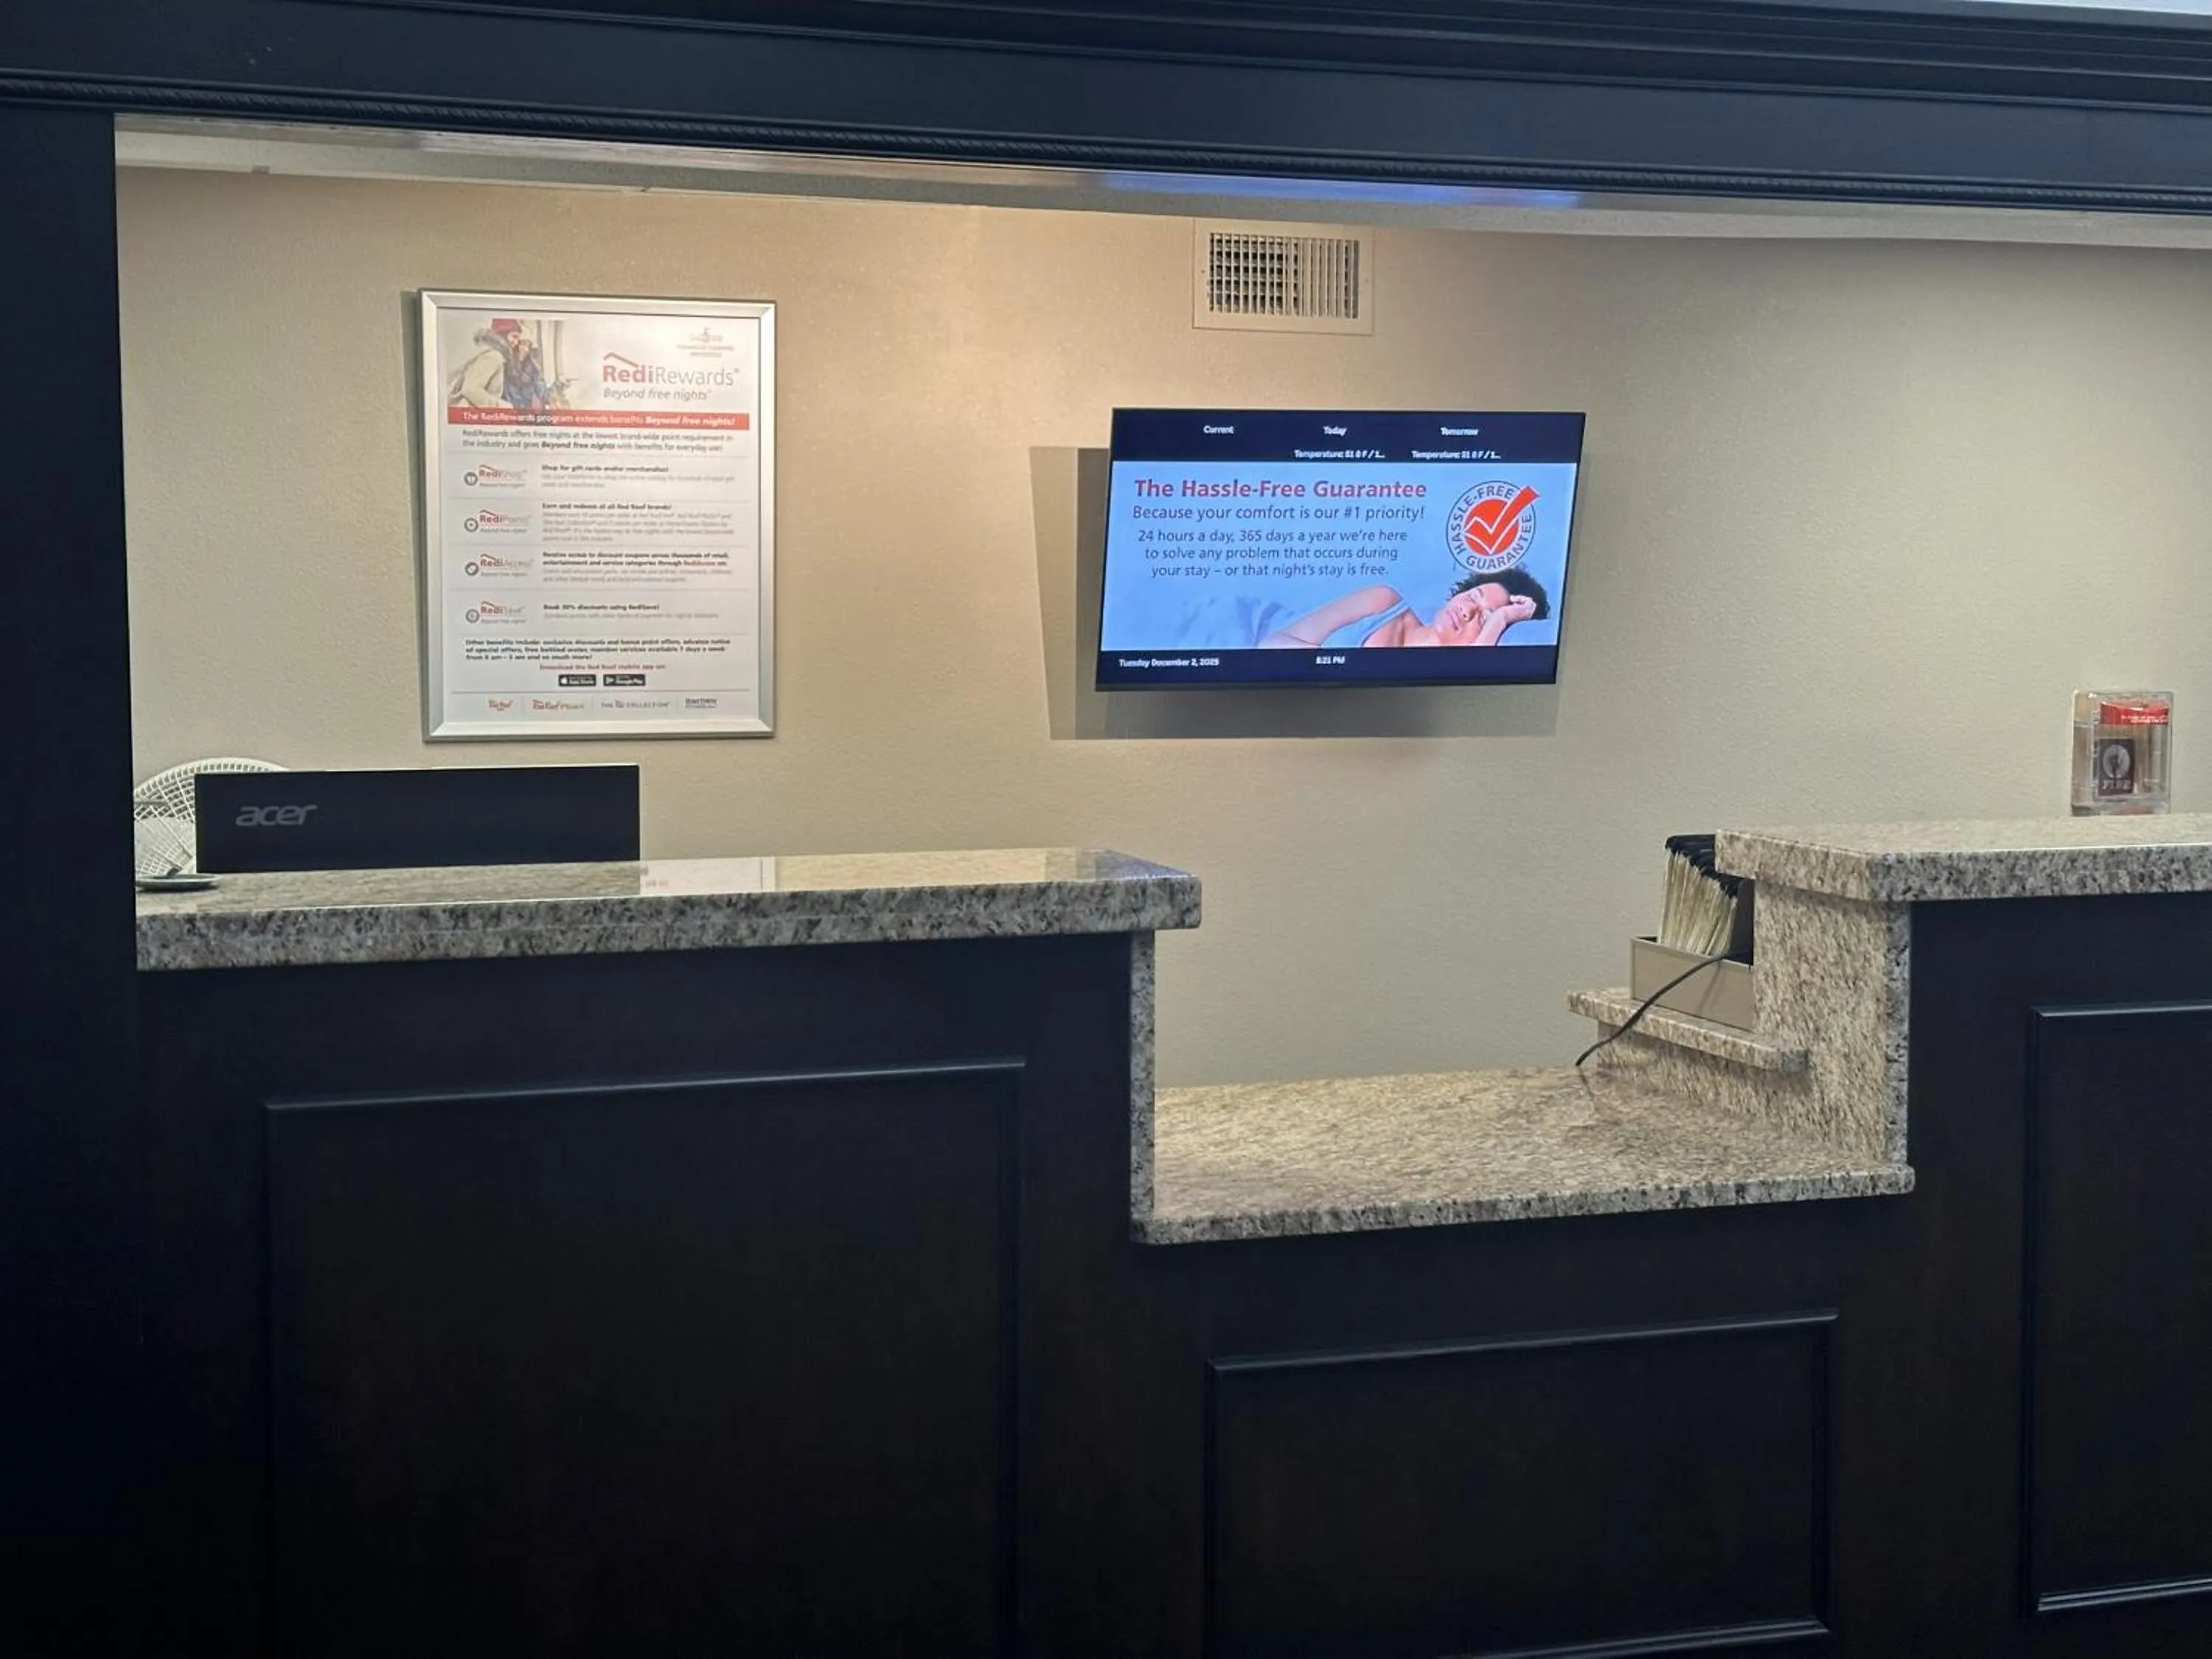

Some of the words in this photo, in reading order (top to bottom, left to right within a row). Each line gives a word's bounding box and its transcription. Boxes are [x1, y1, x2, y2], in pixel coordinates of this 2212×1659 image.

[602, 364, 734, 386] RediRewards
[603, 387, 645, 401] Beyond
[648, 388, 671, 399] free
[673, 389, 708, 402] nights
[463, 411, 479, 421] The
[536, 414, 574, 426] program
[645, 415, 681, 427] Beyond
[682, 415, 702, 425] free
[703, 416, 736, 428] nights!
[1203, 425, 1234, 434] Current
[1323, 425, 1348, 436] Today
[1440, 426, 1478, 436] Tomorrow
[541, 440, 571, 451] Beyond
[573, 441, 589, 449] free
[591, 441, 615, 451] nights
[1135, 479, 1174, 498] The
[1181, 479, 1306, 498] Hassle-Free
[1313, 480, 1427, 498] Guarantee
[1133, 505, 1192, 519] Because
[1196, 507, 1233, 523] your
[1235, 504, 1295, 519] comfort
[1300, 505, 1310, 518] is
[1314, 507, 1340, 519] our
[1344, 506, 1360, 519] #1
[1366, 505, 1425, 522] priority!
[1451, 484, 1514, 555] HASSLE-FREE
[1138, 530, 1154, 542] 24
[1158, 529, 1194, 542] hours
[1197, 532, 1206, 542] a
[1209, 529, 1235, 544] day,
[1239, 529, 1262, 542] 365
[1266, 529, 1294, 544] days
[1298, 532, 1305, 542] a
[1309, 532, 1336, 544] year
[1340, 529, 1375, 542] we're
[1378, 529, 1408, 542] here
[1466, 513, 1532, 570] GUARANTEE
[1145, 549, 1158, 560] to
[1163, 546, 1195, 560] solve
[1199, 549, 1222, 561] any
[1225, 546, 1279, 561] problem
[1284, 547, 1311, 559] that
[1313, 549, 1353, 560] occurs
[1356, 546, 1398, 561] during
[1152, 566, 1181, 579] your
[1185, 566, 1211, 579] stay
[1225, 566, 1239, 576] or
[1242, 565, 1269, 576] that
[1273, 564, 1315, 579] night's
[1318, 565, 1344, 577] stay
[1347, 563, 1356, 576] is
[1360, 563, 1388, 576] free.
[1119, 658, 1150, 668] Tuesday
[1151, 657, 1190, 667] December
[1200, 657, 1220, 667] 2025
[1332, 655, 1346, 664] PM
[235, 804, 318, 827] acer
